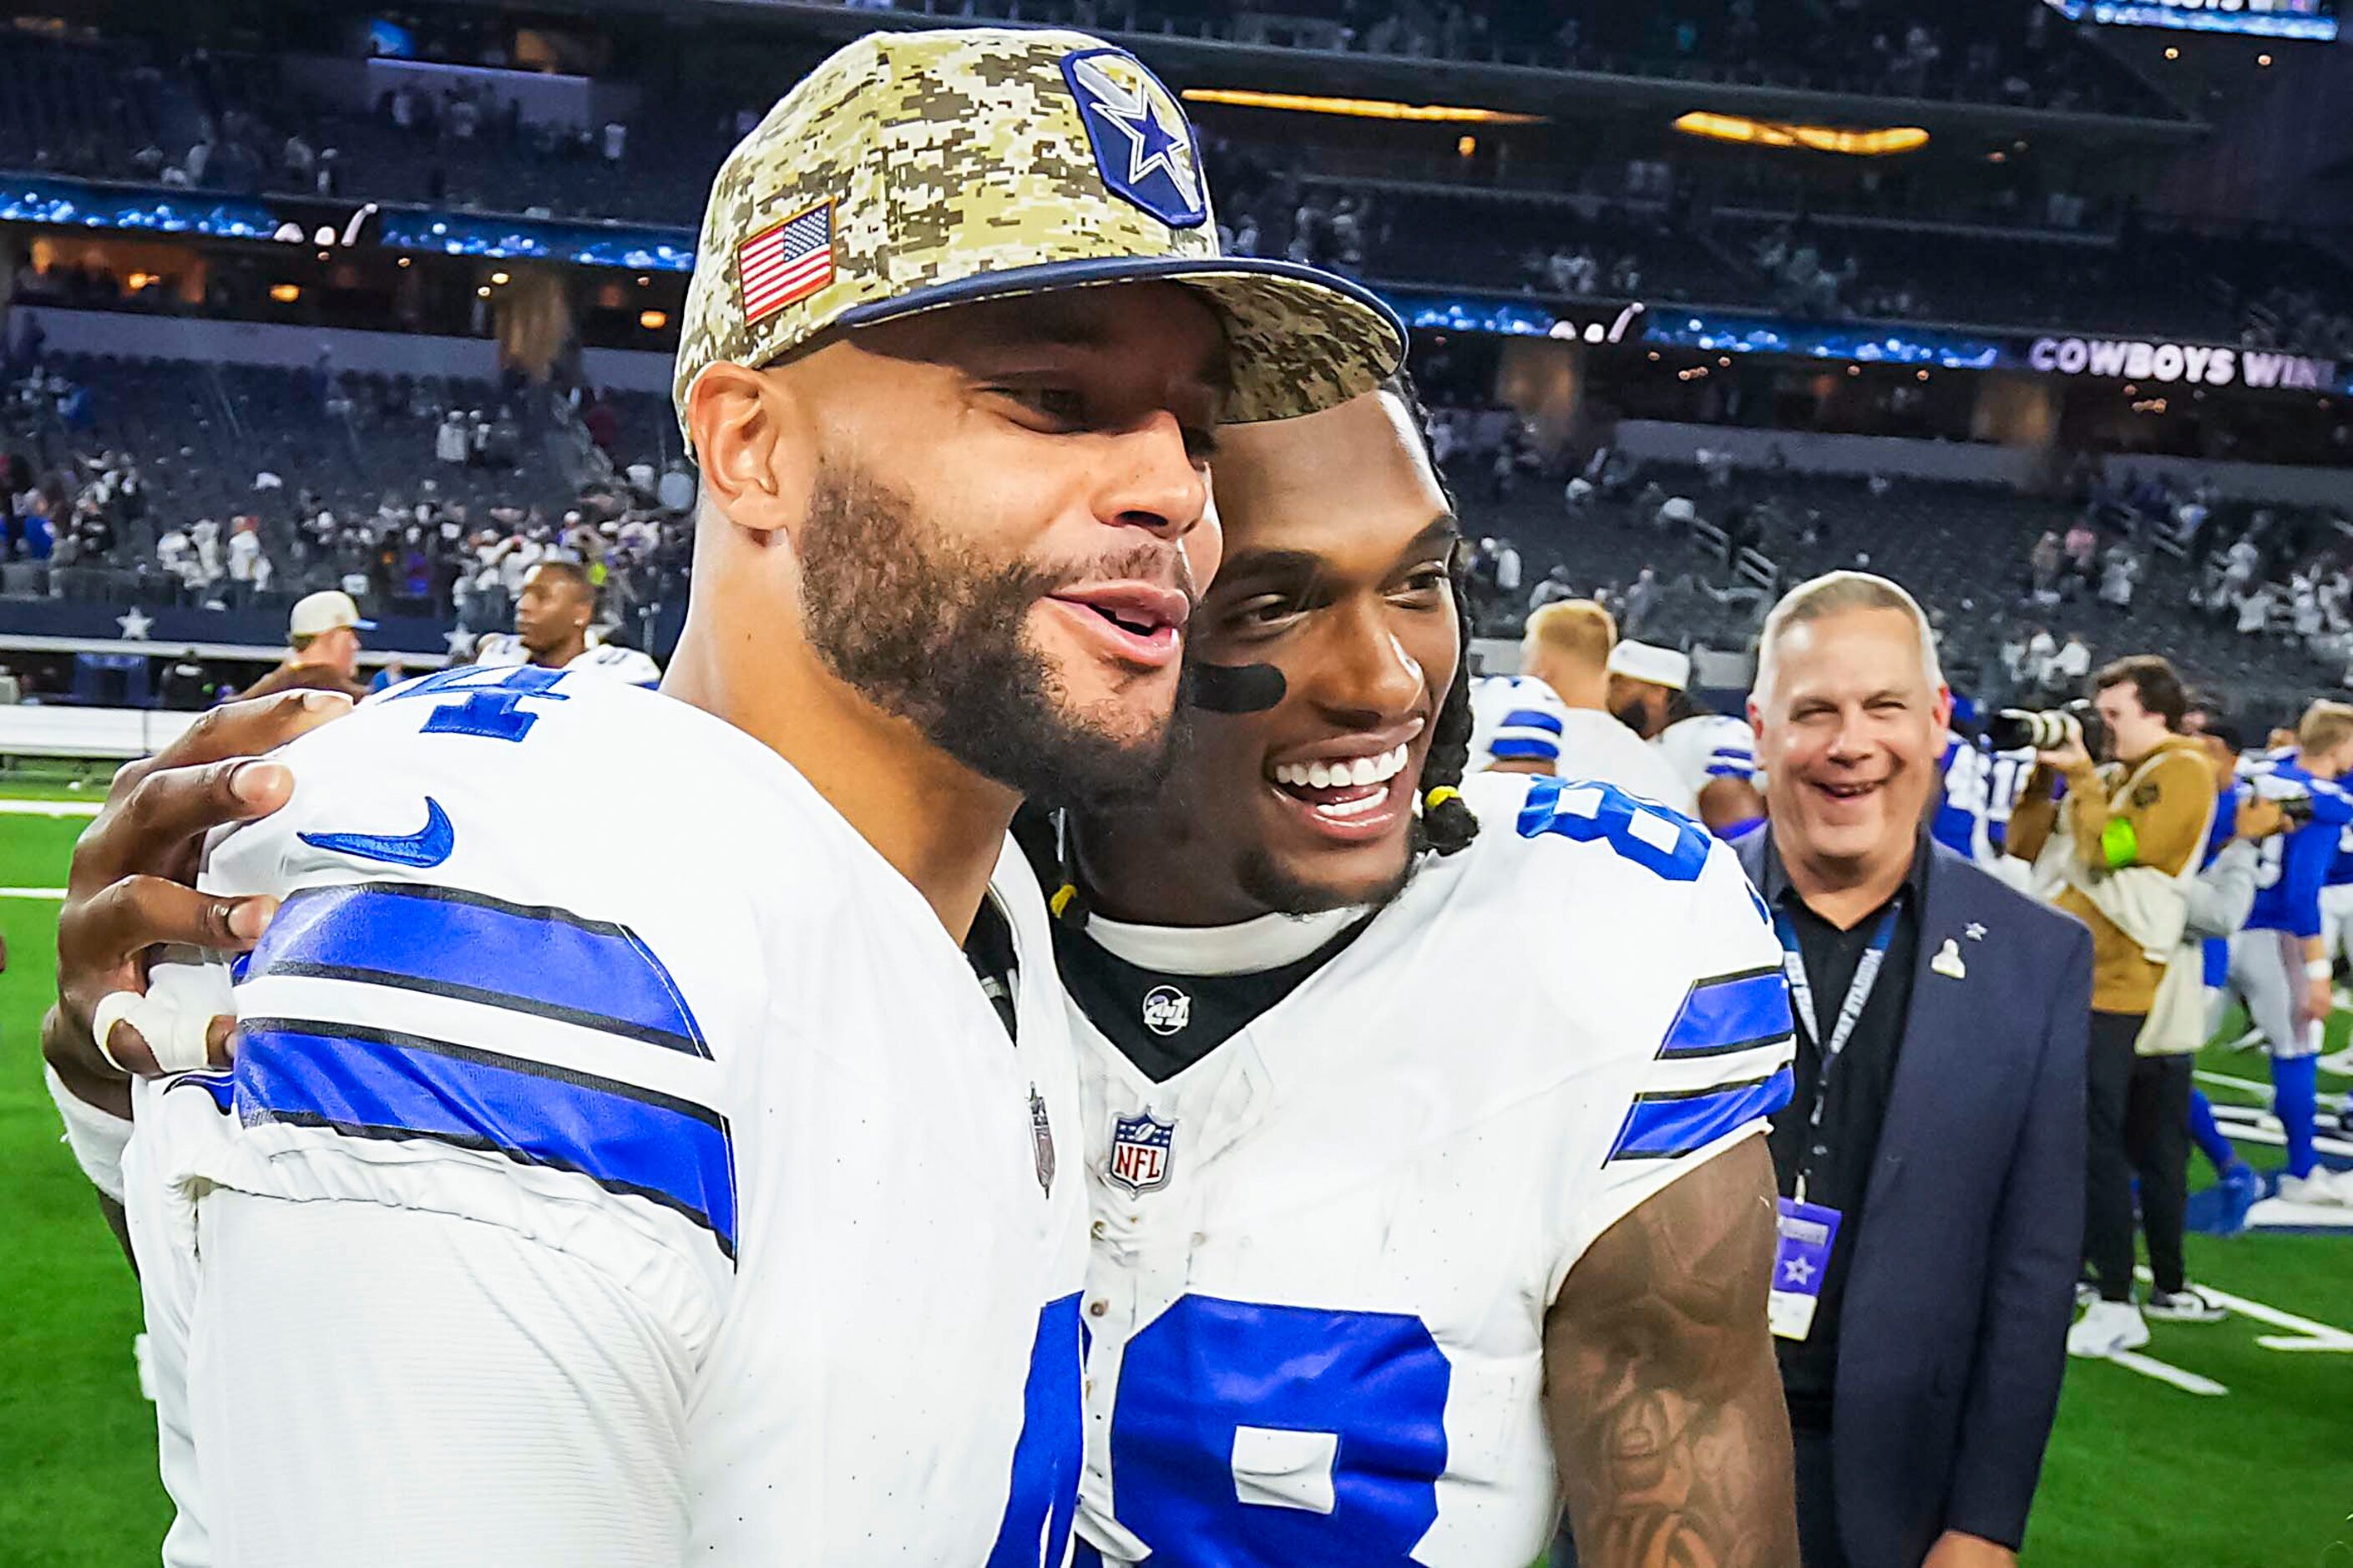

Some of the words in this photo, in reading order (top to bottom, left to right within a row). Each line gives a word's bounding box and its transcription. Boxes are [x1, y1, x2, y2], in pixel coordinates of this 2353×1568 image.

[2030, 337, 2236, 386] COWBOYS
[1114, 1144, 1161, 1182] NFL
[1080, 1292, 1451, 1568] 8
